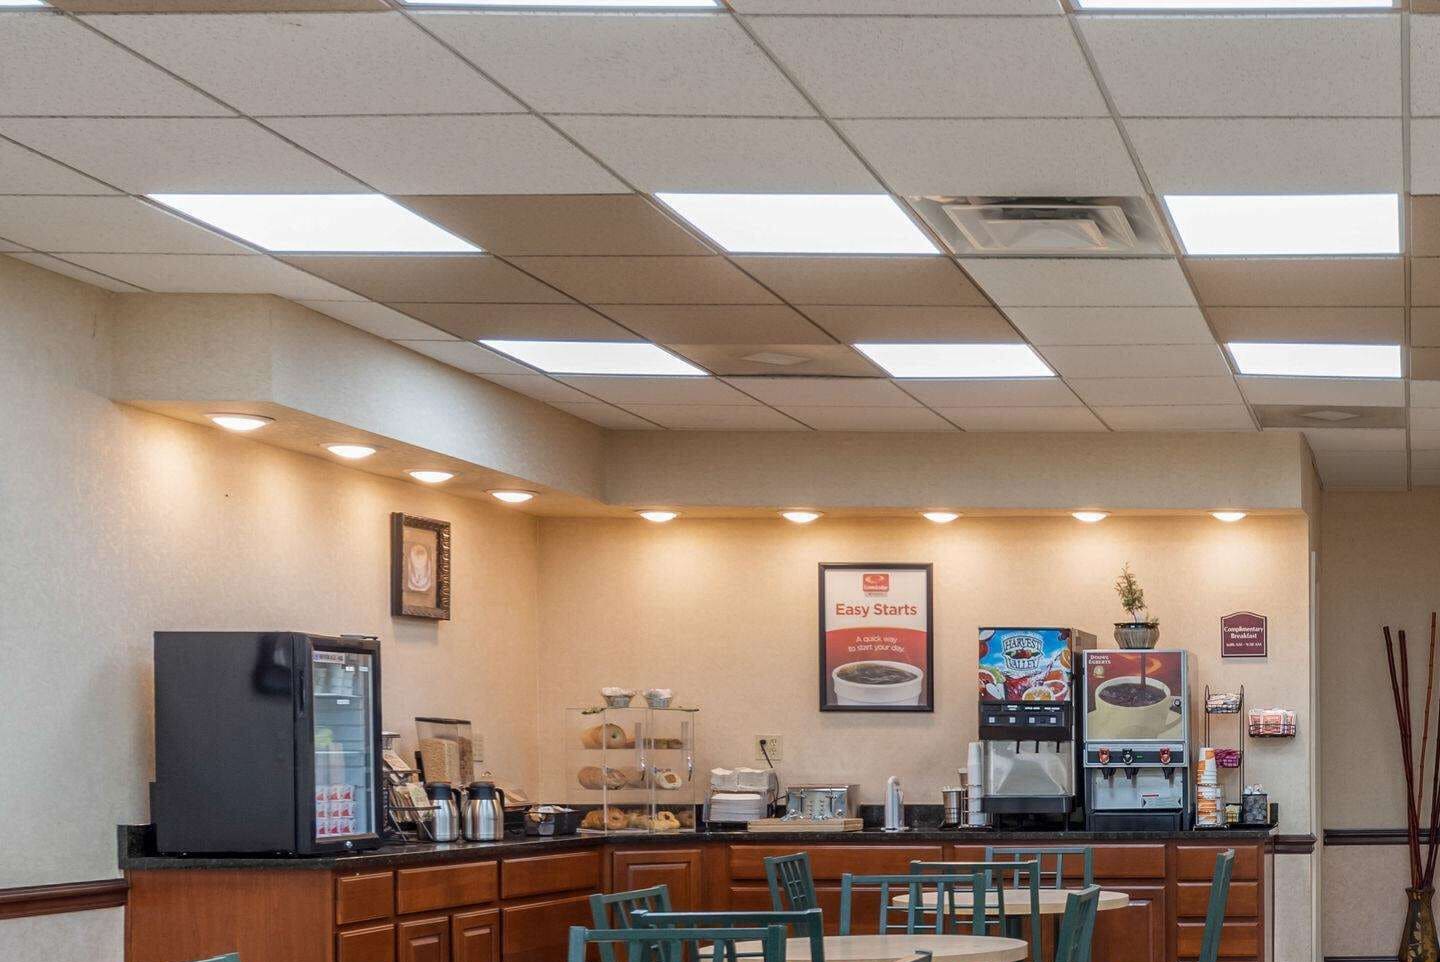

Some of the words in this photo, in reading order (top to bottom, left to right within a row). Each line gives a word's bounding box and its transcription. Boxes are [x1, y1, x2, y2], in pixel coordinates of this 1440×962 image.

[836, 603, 870, 617] Easy
[874, 603, 917, 615] Starts
[1004, 636, 1042, 650] HARVEST
